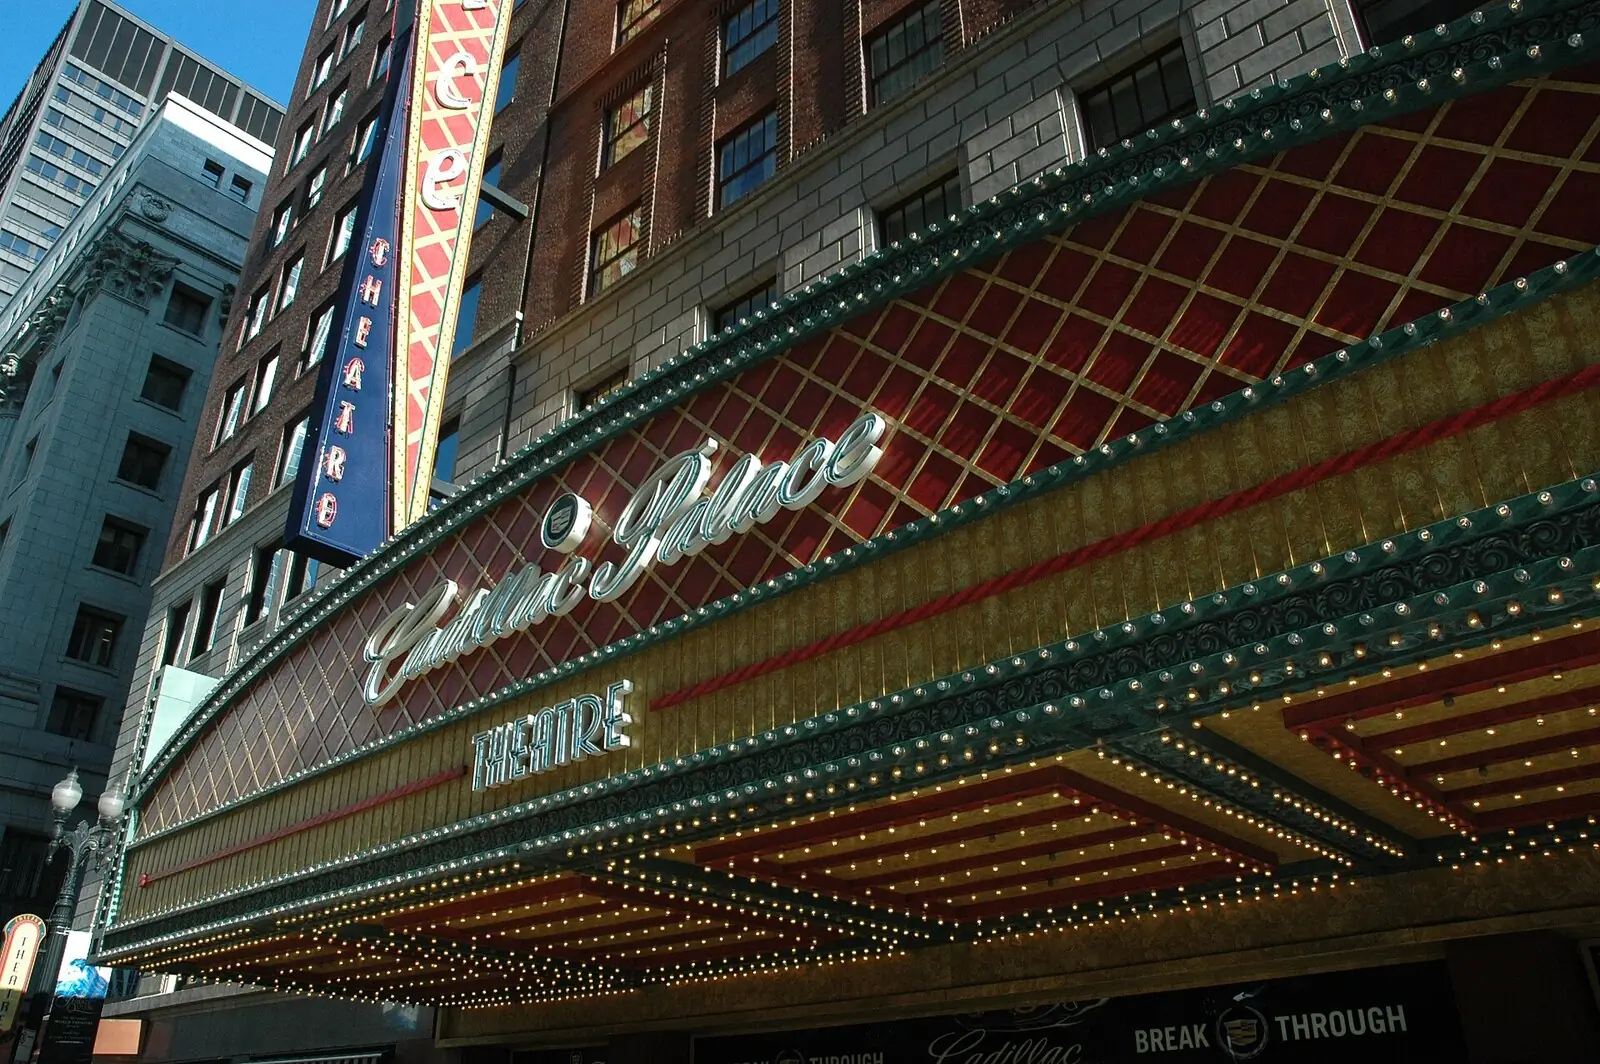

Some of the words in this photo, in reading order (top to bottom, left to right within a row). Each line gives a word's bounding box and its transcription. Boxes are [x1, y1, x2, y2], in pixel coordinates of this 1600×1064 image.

[363, 556, 592, 706] Cadillac
[589, 411, 887, 602] Palace
[471, 678, 634, 793] THEATRE
[1134, 1023, 1209, 1054] BREAK
[1274, 1004, 1408, 1043] THROUGH
